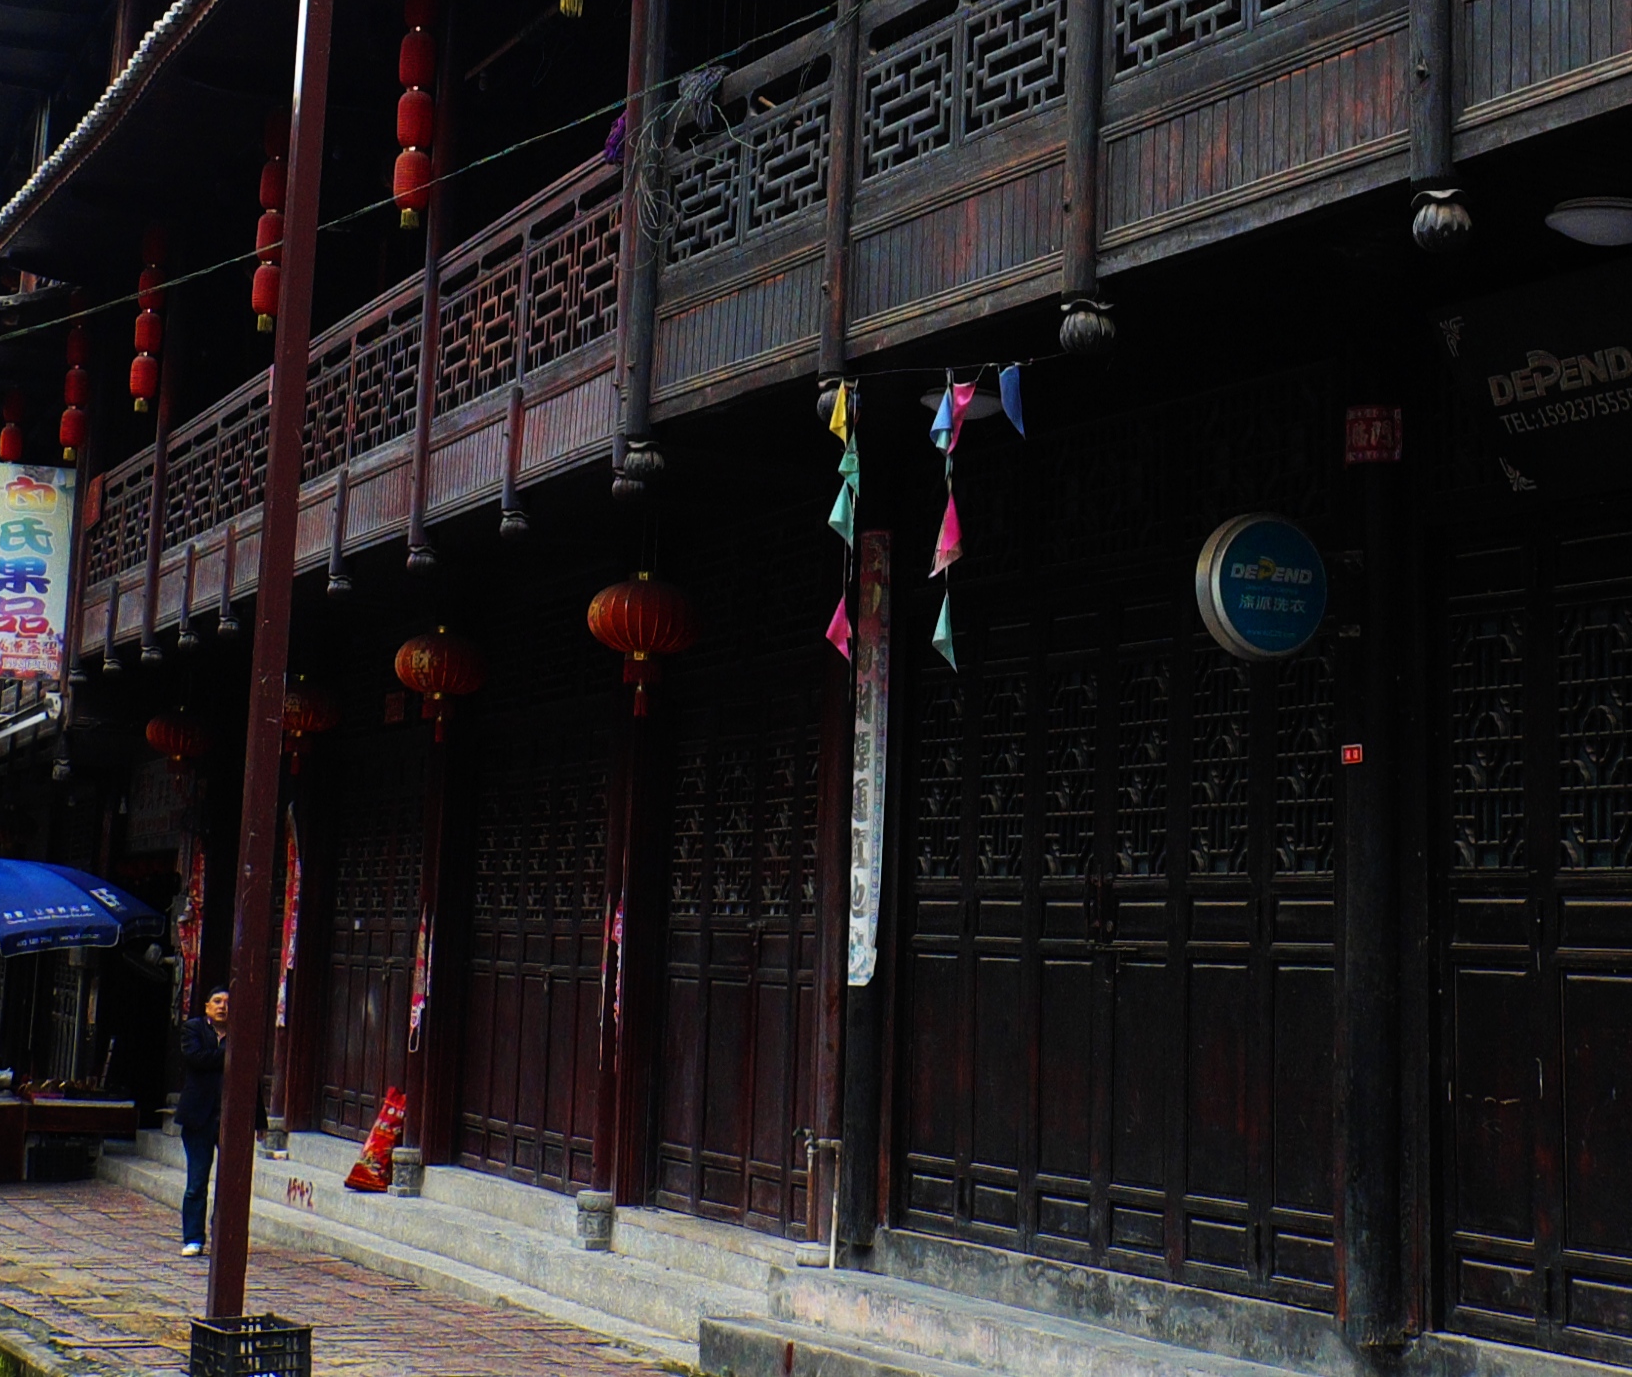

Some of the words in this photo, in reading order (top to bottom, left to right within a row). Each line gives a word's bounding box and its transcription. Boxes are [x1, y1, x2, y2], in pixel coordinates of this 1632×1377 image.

[1230, 555, 1313, 584] DEPEND
[1238, 593, 1308, 615] 涤派洗衣
